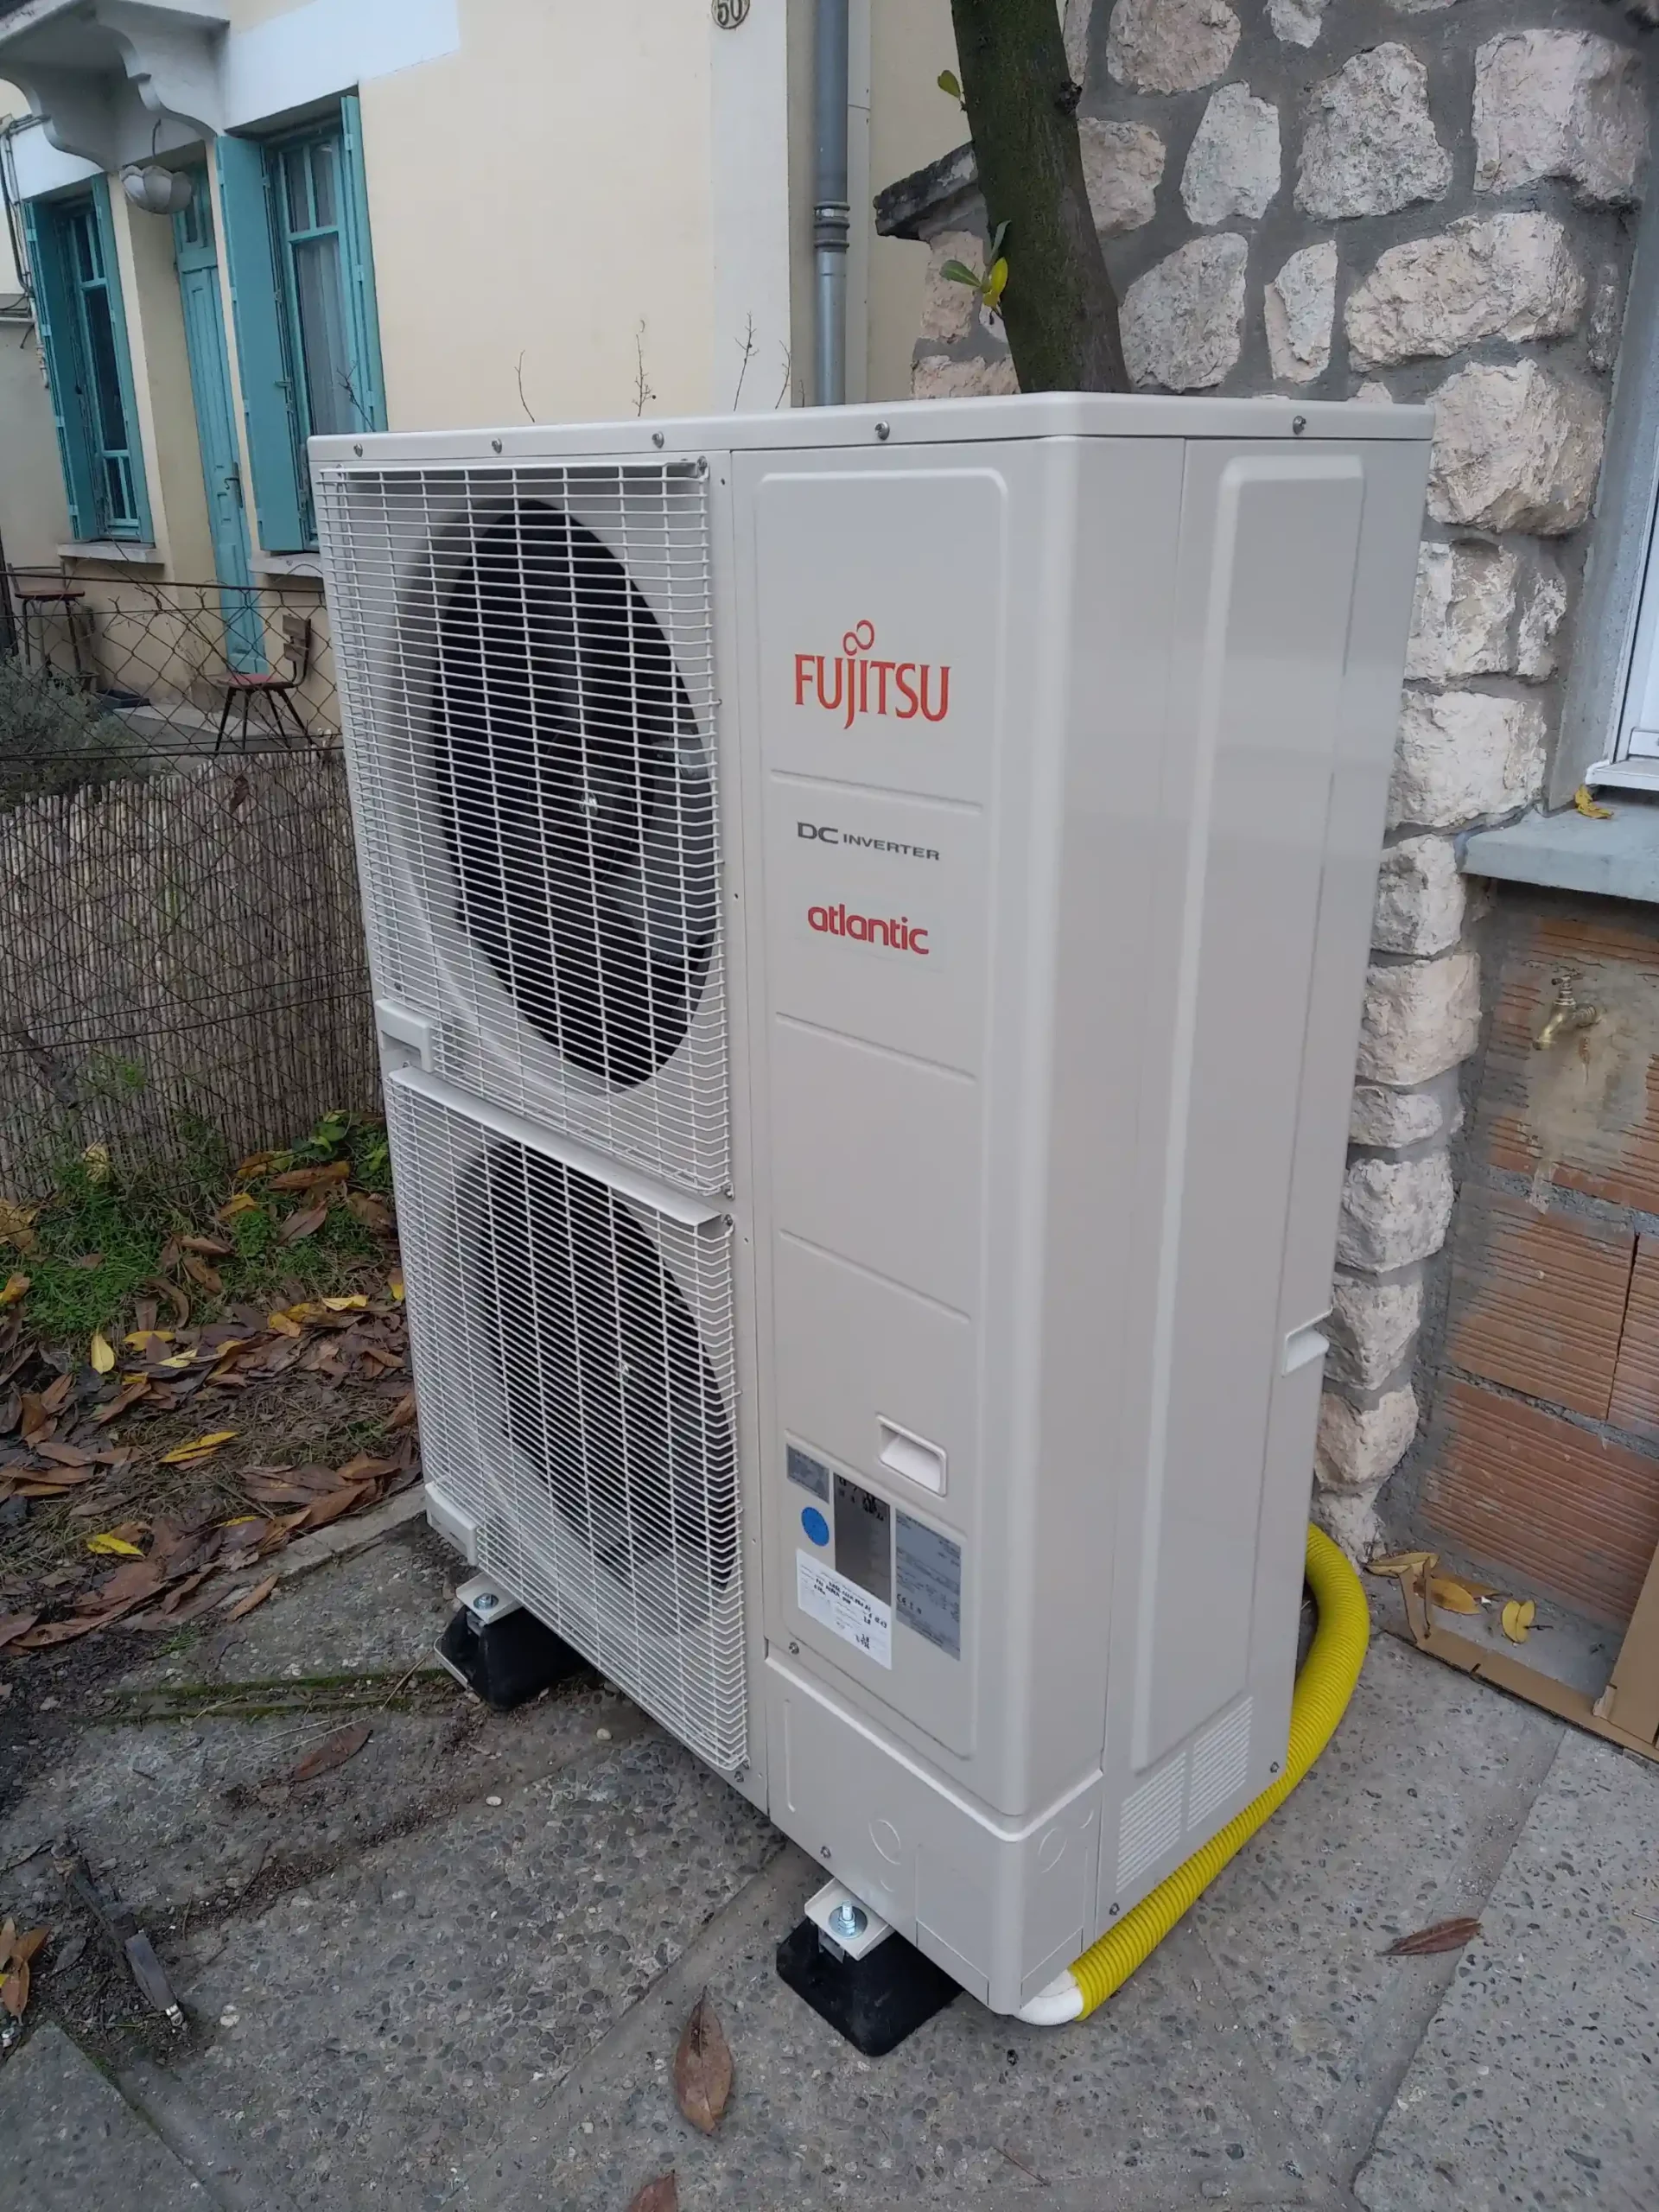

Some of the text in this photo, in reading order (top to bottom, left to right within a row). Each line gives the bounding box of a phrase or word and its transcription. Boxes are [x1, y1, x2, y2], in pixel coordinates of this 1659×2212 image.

[717, 0, 742, 26] 50
[794, 652, 951, 730] FUJITSU
[797, 821, 940, 861] DC INVERTER
[807, 903, 930, 955] atlantic
